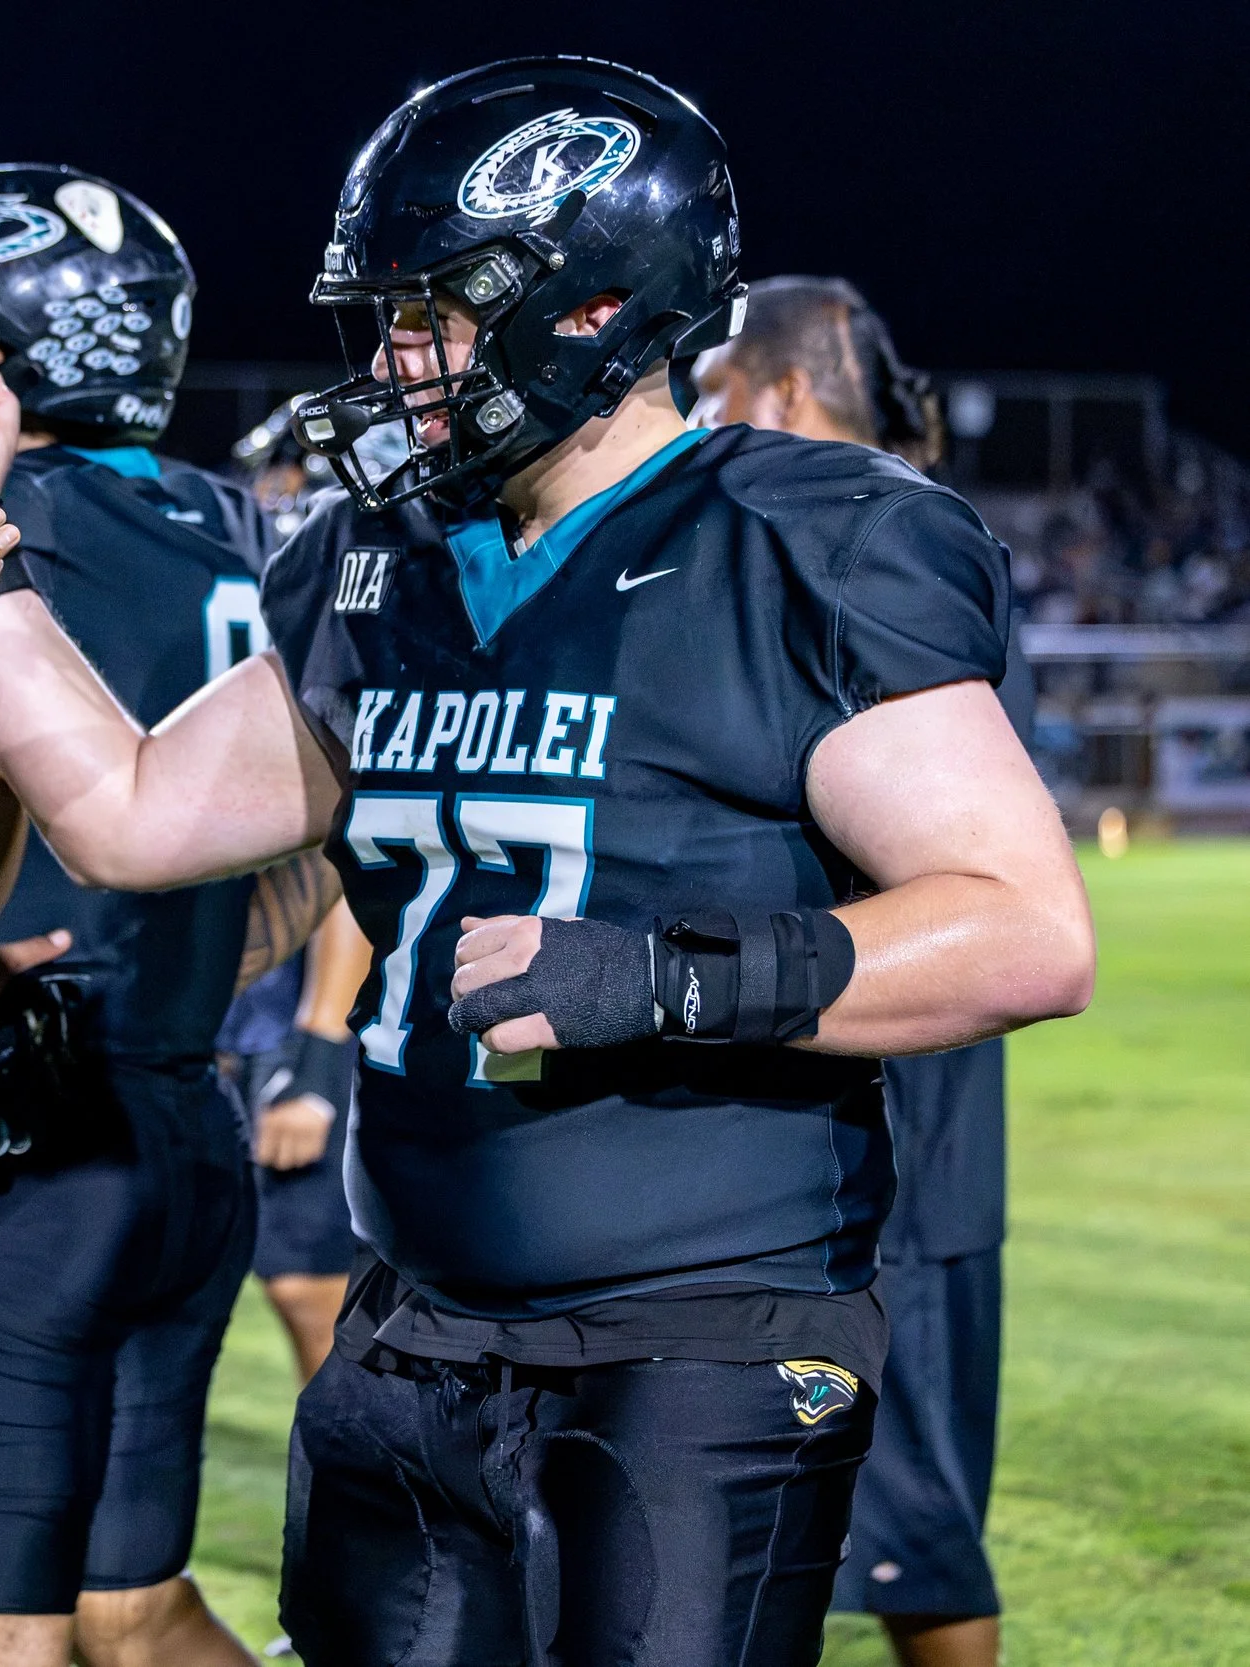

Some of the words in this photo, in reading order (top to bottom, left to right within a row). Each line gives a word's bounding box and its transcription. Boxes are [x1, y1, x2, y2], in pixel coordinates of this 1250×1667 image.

[529, 137, 579, 190] K
[299, 404, 329, 417] SHOCK
[335, 551, 389, 611] OIA
[350, 688, 617, 780] KAPOLEI
[344, 790, 595, 1088] 77
